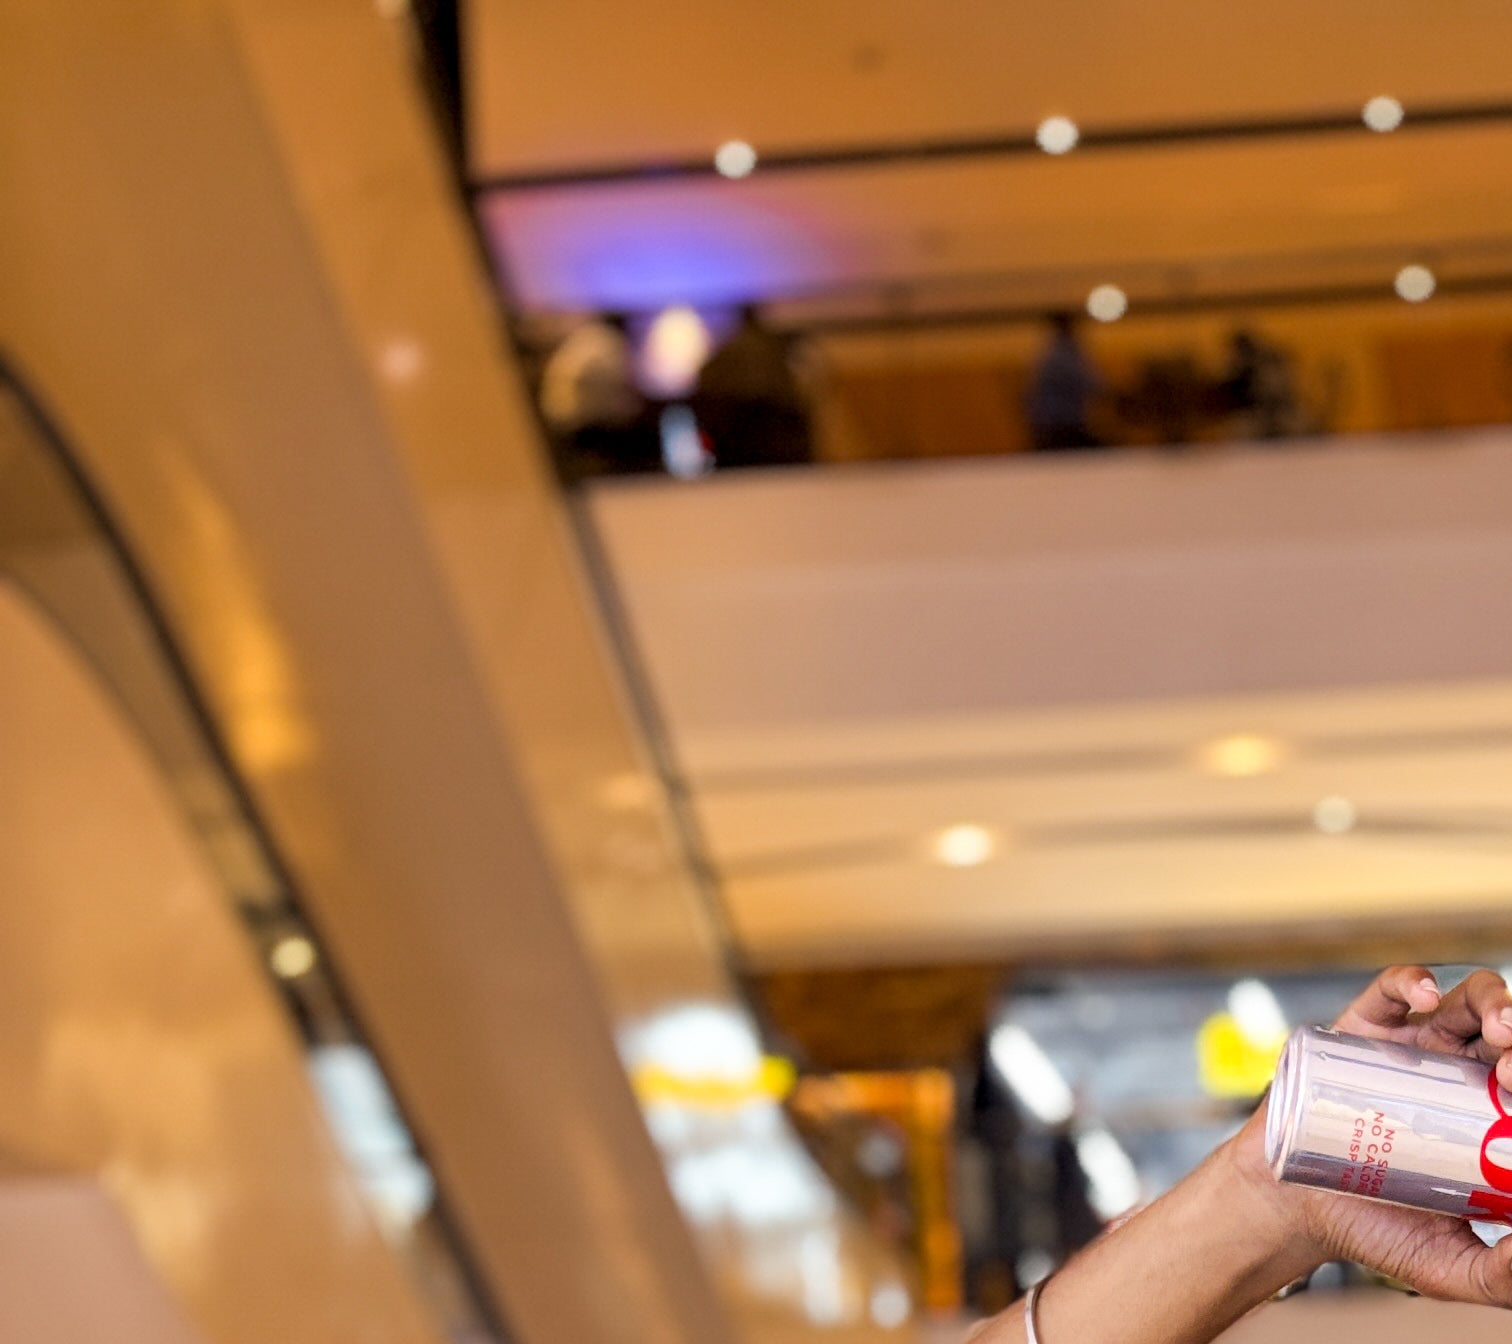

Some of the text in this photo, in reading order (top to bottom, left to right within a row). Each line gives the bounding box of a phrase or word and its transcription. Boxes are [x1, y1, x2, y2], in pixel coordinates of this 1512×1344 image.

[1371, 1111, 1384, 1137] NO
[1348, 1117, 1364, 1163] CRISP
[1381, 1128, 1395, 1153] NO
